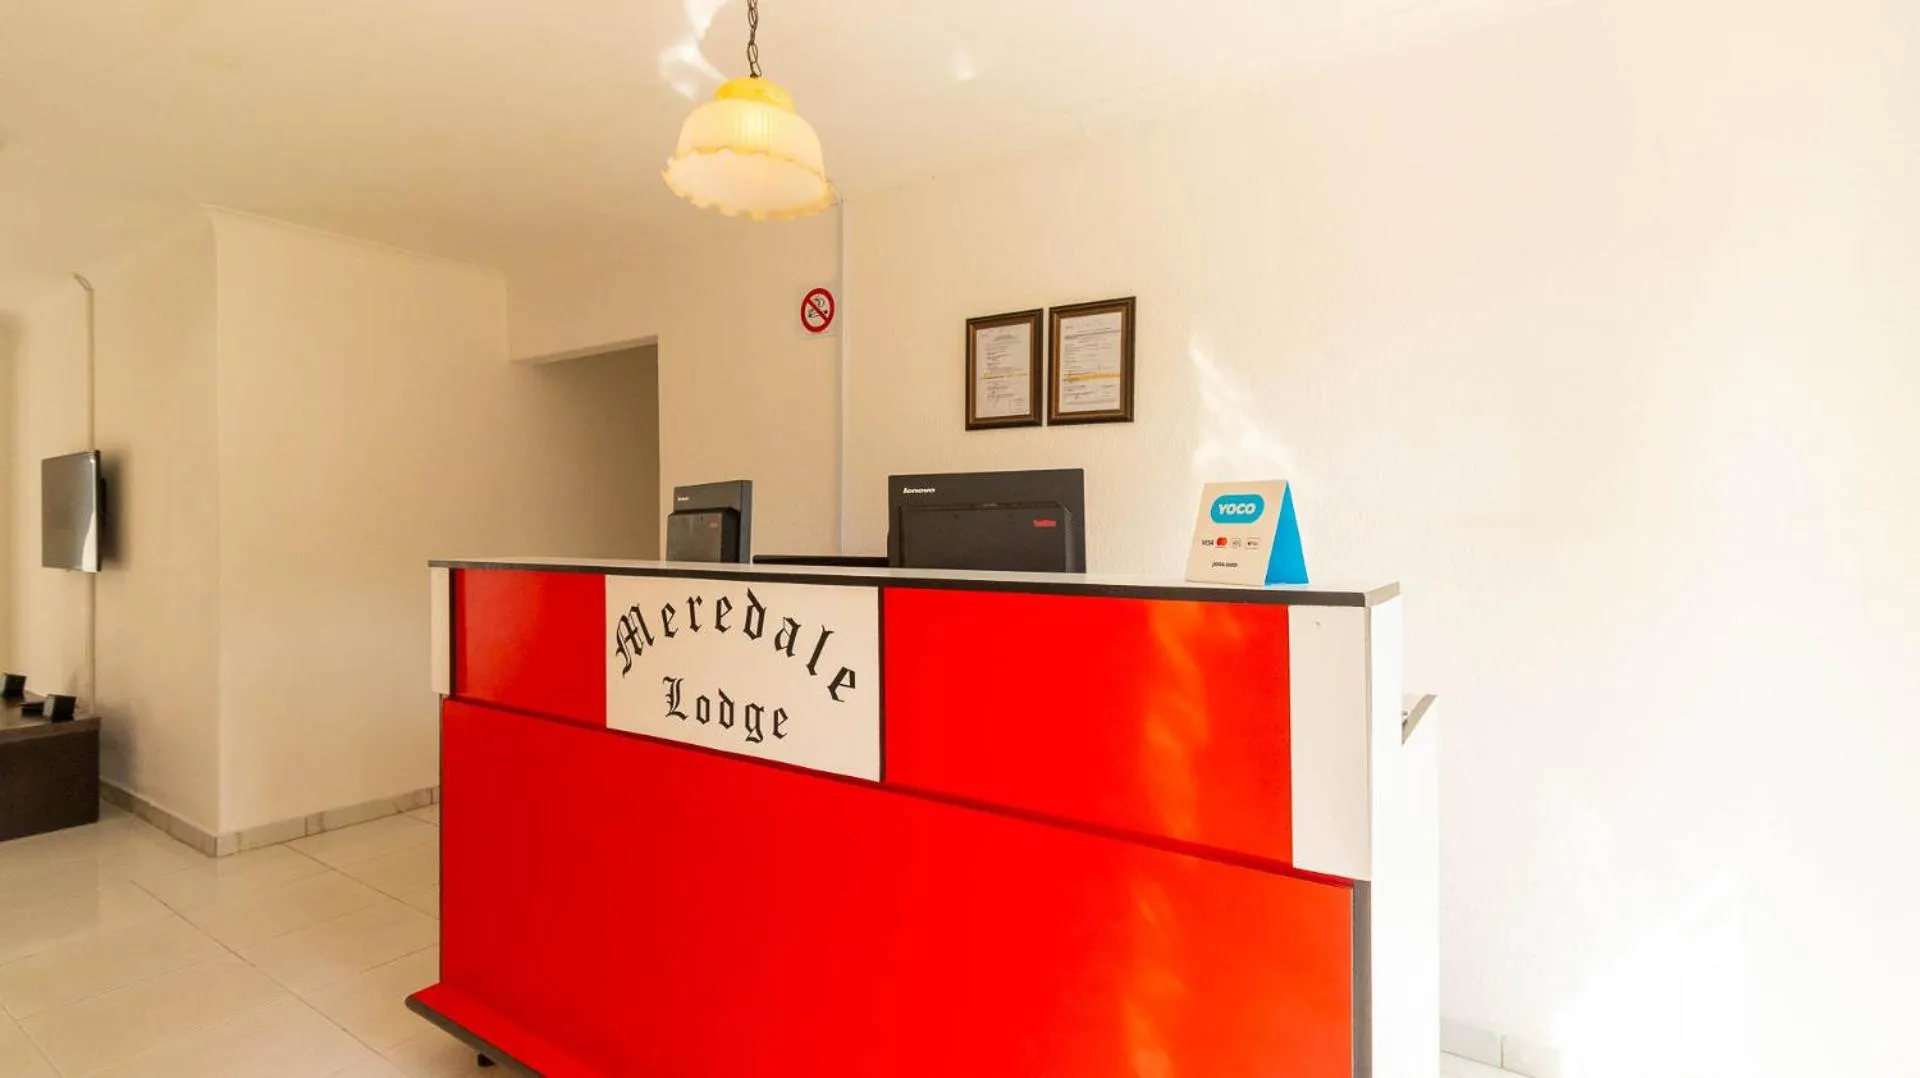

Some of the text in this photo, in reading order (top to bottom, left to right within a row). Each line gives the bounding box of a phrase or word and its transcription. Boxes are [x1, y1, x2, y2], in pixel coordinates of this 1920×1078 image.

[1218, 503, 1257, 515] YOCO
[616, 587, 857, 703] Meredale
[662, 676, 789, 744] Lodge
